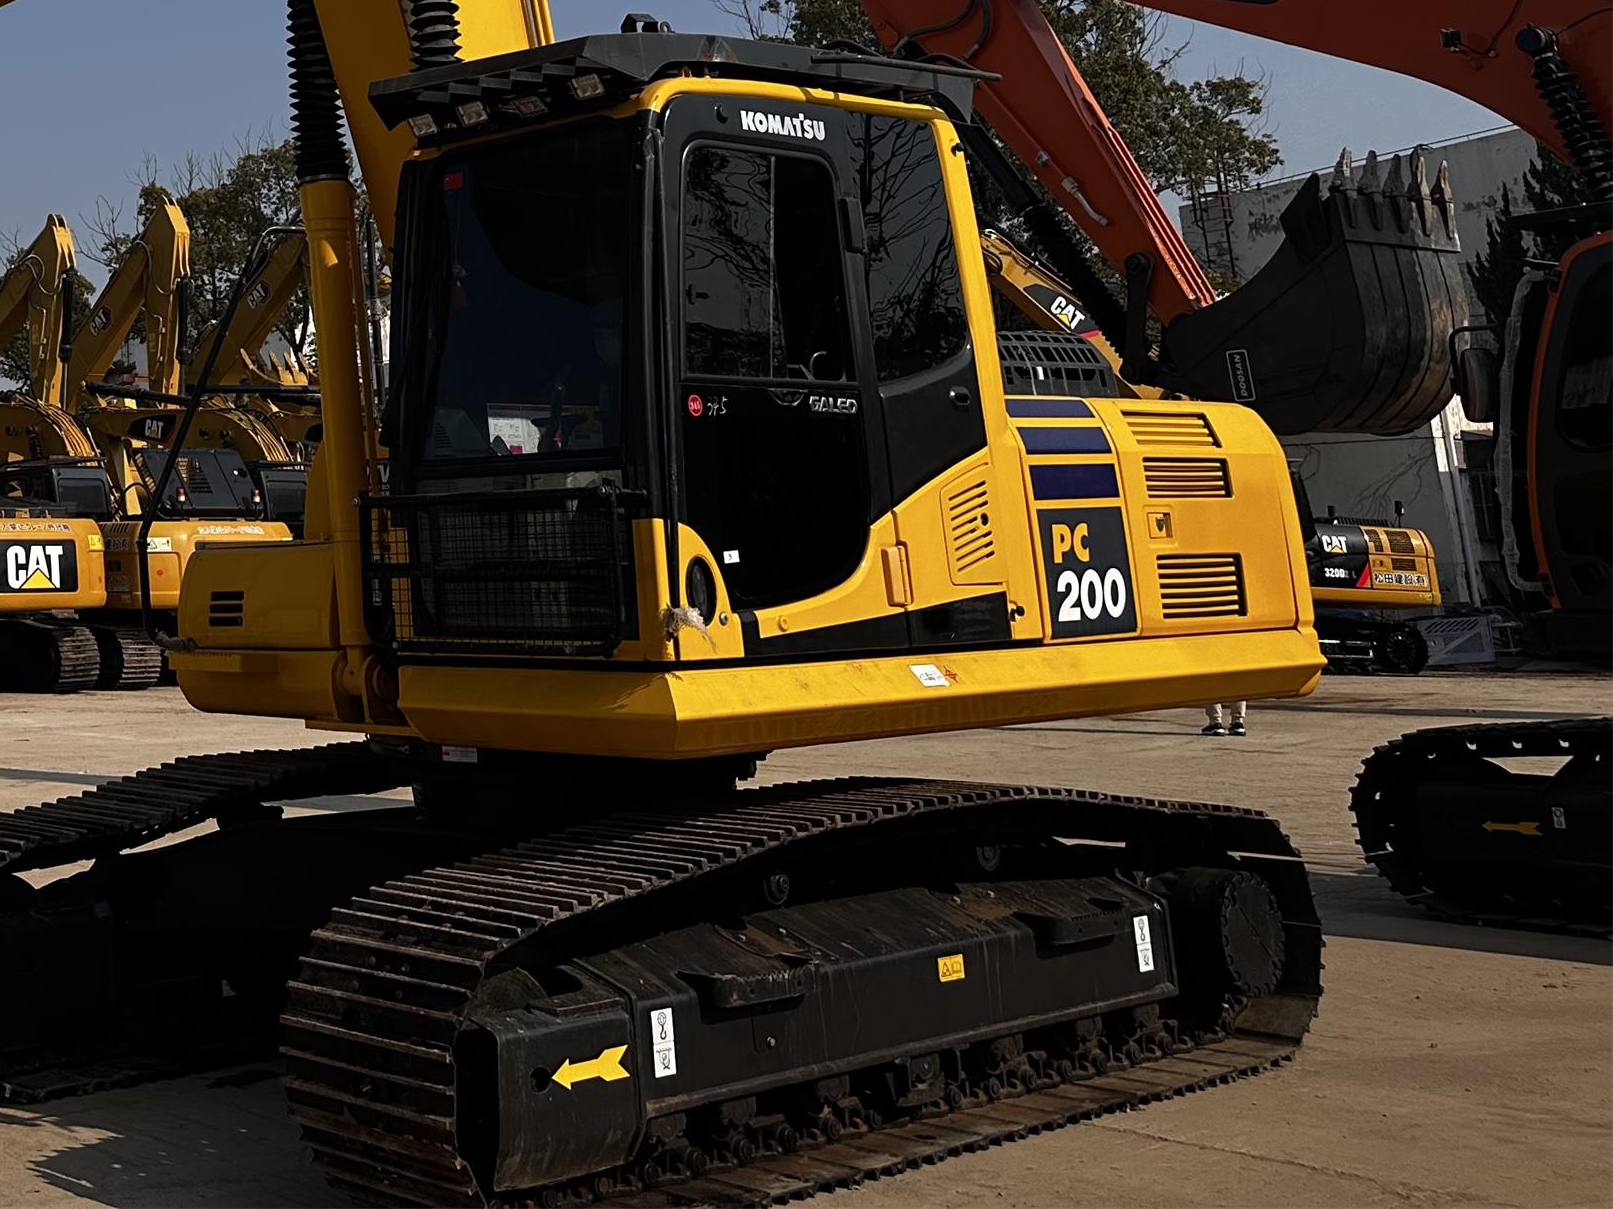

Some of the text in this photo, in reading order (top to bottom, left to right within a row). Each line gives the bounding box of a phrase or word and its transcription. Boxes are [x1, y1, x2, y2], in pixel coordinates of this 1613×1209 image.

[741, 110, 825, 141] KOMATSU
[247, 283, 266, 309] CAT
[89, 308, 107, 336] CAT
[1050, 296, 1085, 330] CAT
[1234, 354, 1249, 397] DOOSAN
[144, 419, 164, 439] CAT
[1051, 523, 1090, 563] PC
[1321, 535, 1348, 554] CAT
[6, 545, 63, 589] CAT
[1057, 567, 1126, 622] 200
